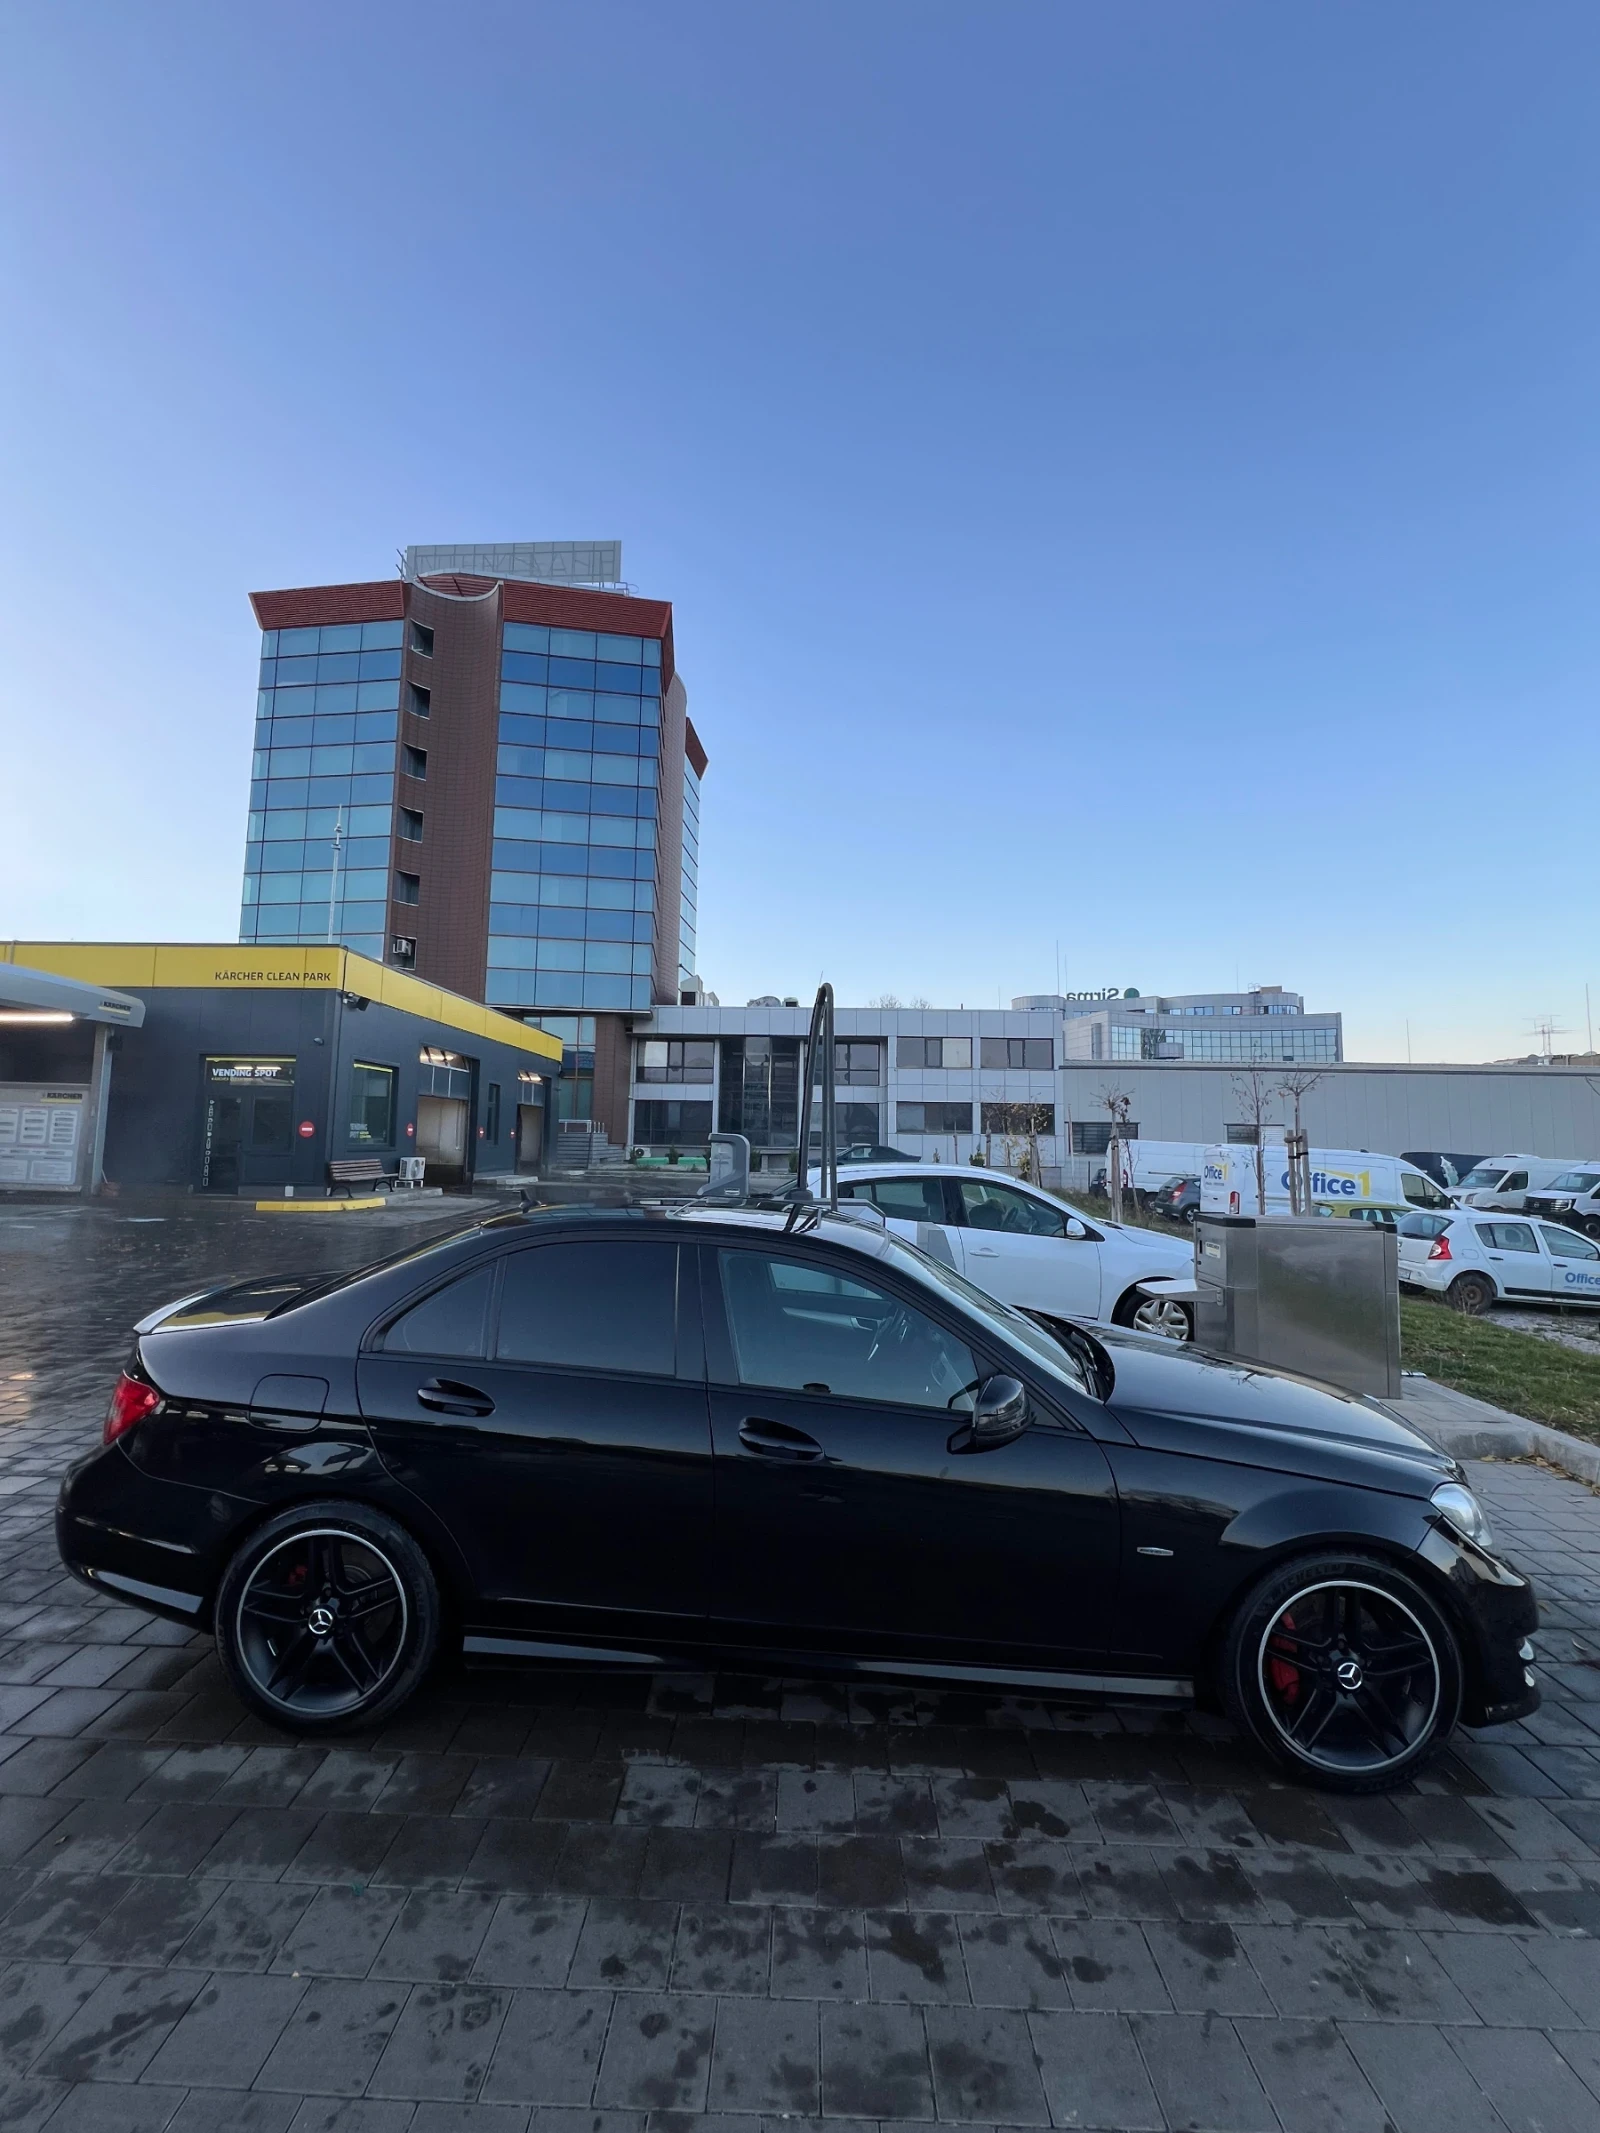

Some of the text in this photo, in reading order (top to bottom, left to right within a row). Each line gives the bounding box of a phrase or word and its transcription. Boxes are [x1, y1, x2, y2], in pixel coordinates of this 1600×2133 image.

[215, 970, 332, 981] KÄRCHER CLEAN PARK
[212, 1068, 278, 1077] VENDING SPOT
